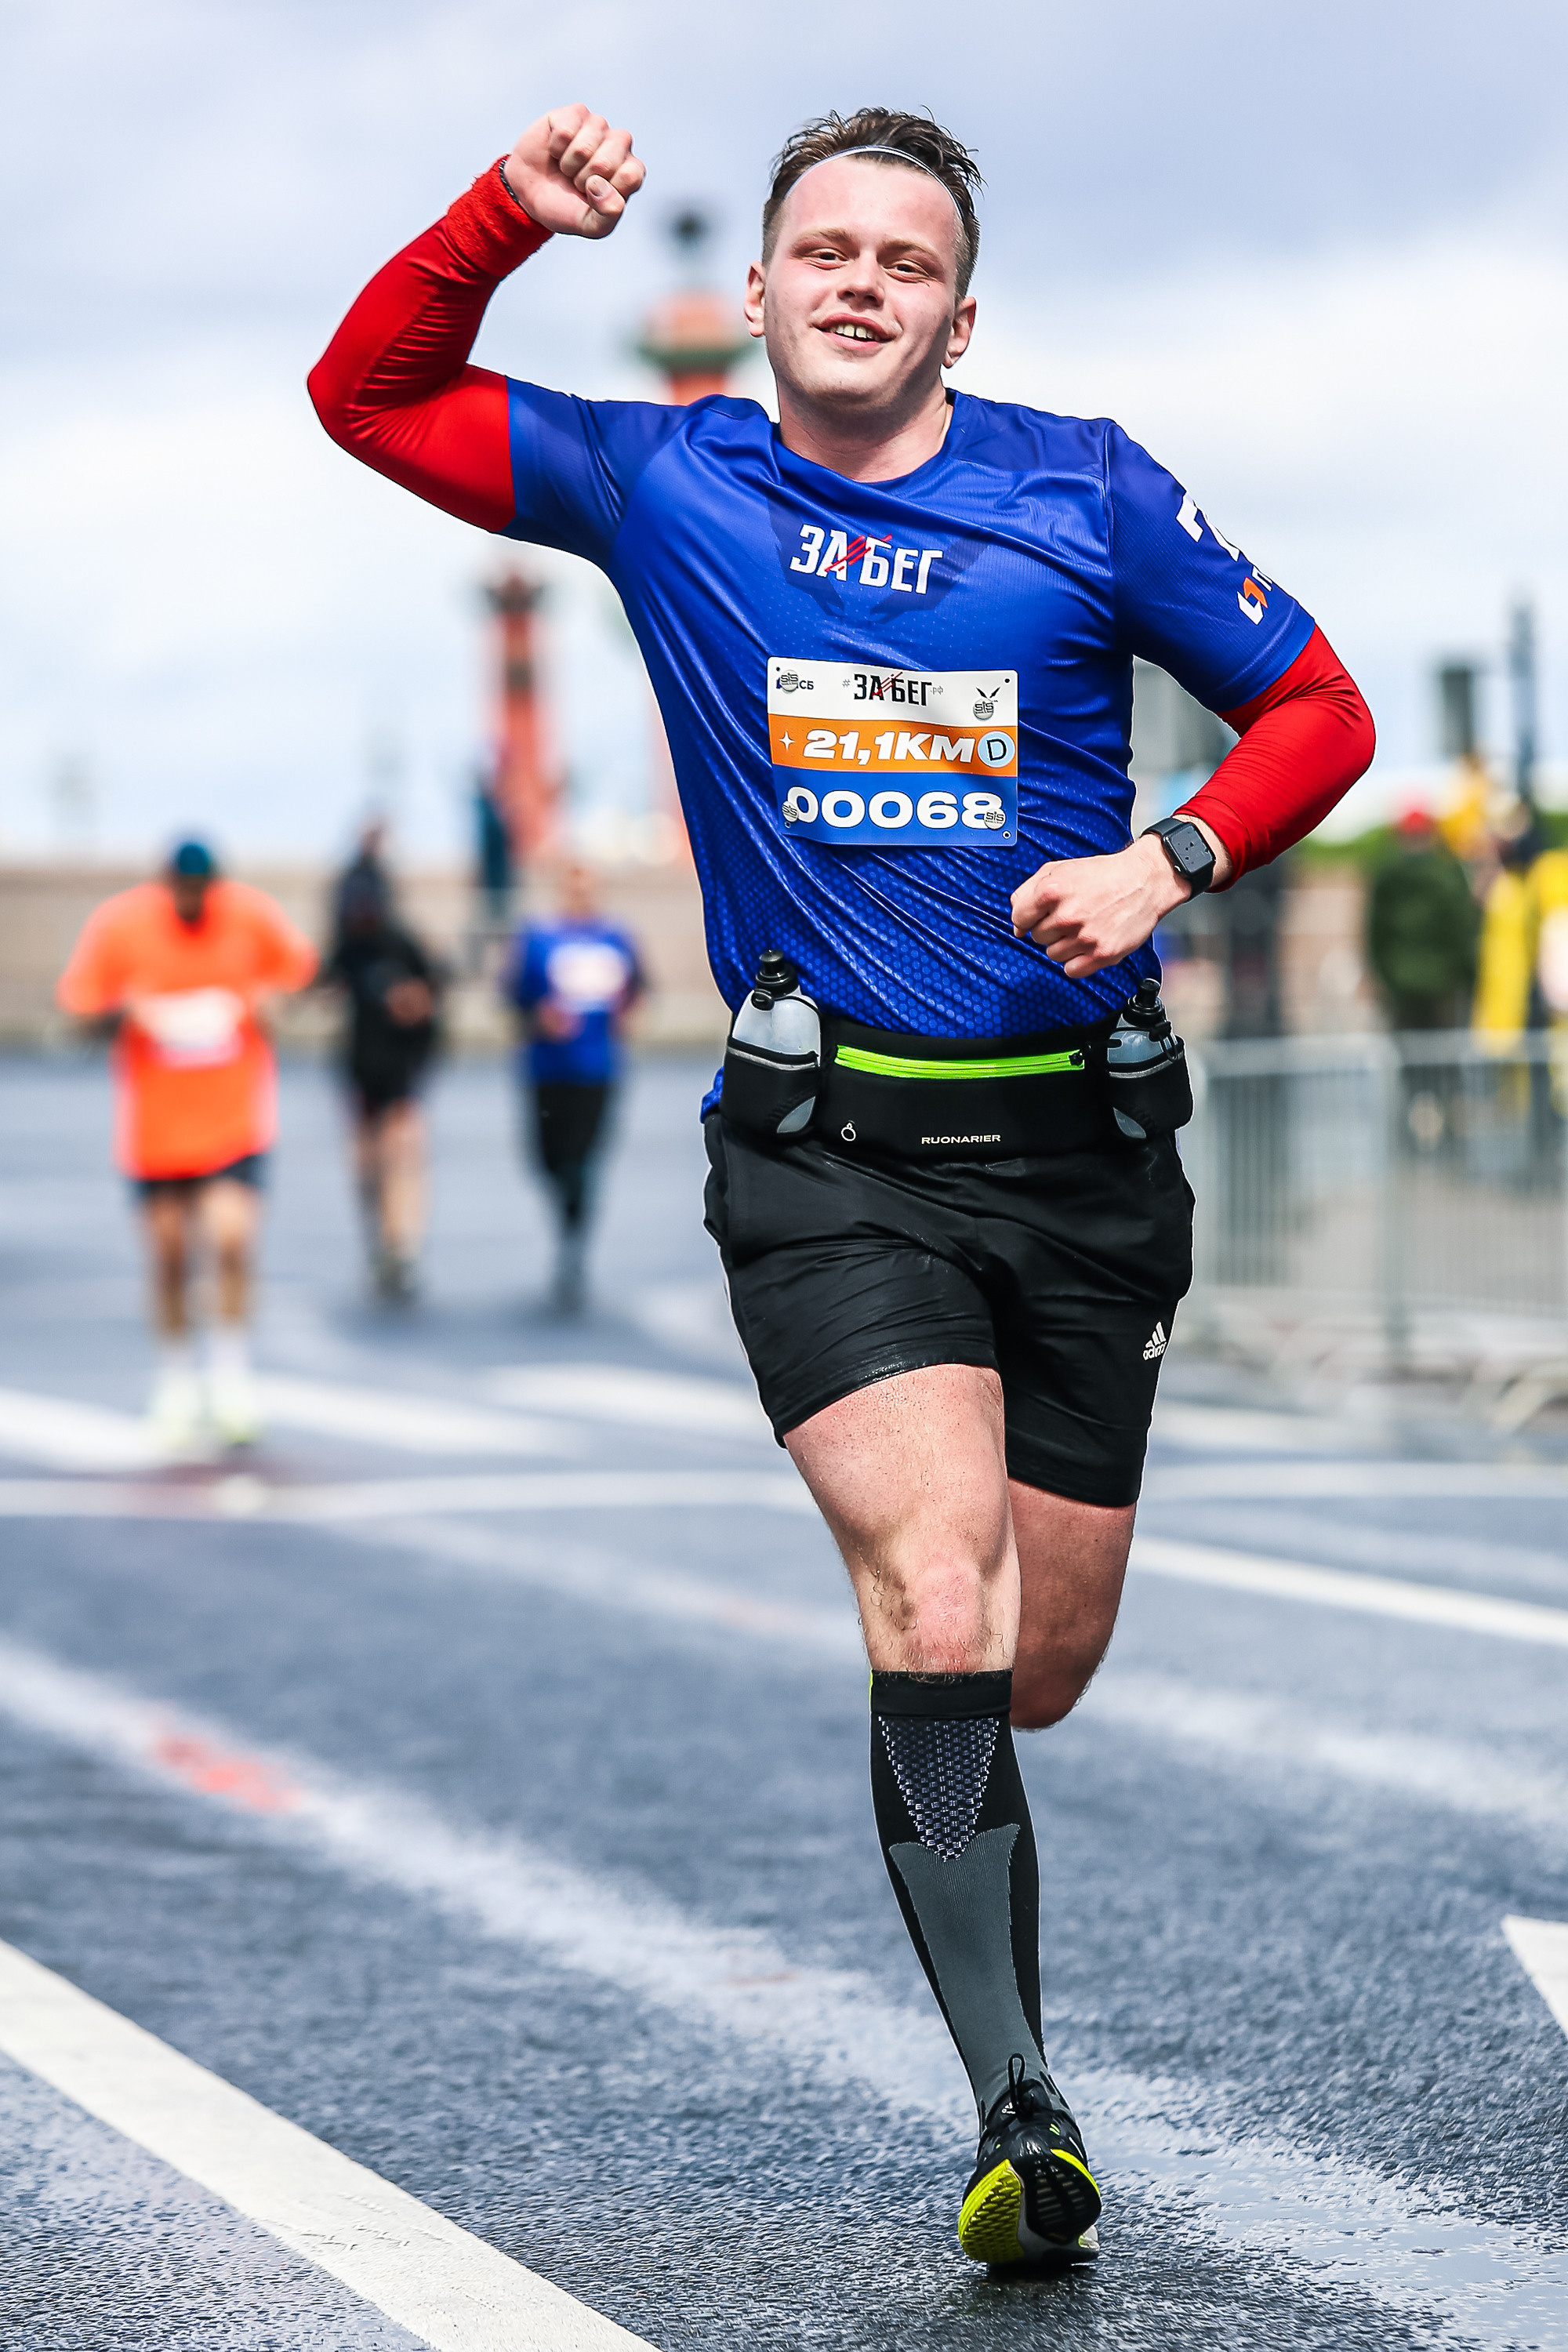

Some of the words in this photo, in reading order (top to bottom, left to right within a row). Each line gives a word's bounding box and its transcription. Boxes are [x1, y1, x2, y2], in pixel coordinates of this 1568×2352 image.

[985, 739, 1007, 761] D
[786, 786, 1003, 829] 00068
[921, 1134, 1001, 1145] RUONARIER
